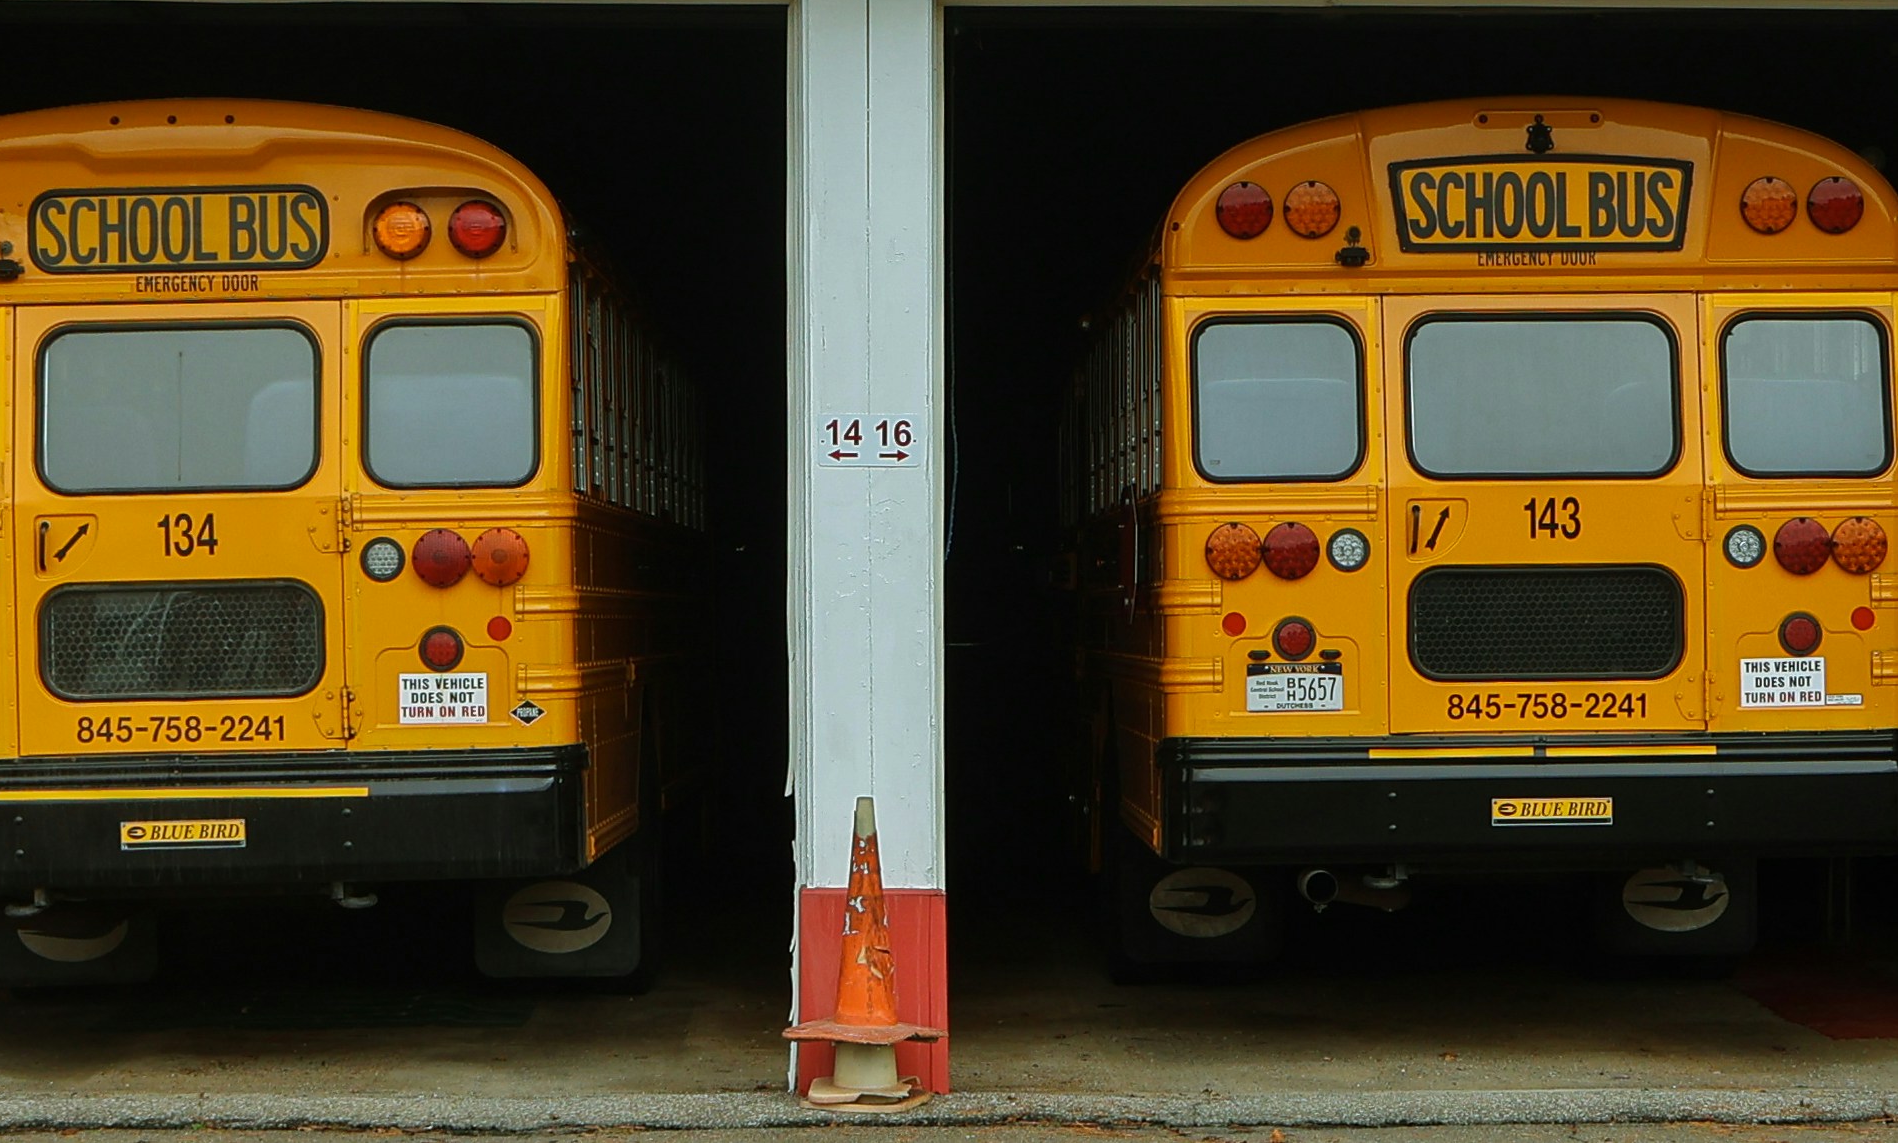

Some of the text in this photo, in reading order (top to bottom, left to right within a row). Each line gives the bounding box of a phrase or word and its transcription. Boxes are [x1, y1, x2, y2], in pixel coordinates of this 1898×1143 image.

[1409, 170, 1675, 239] SCHOOL BUS
[39, 194, 319, 264] SCHOOL BUS
[135, 274, 259, 293] EMERGENCY DOOR
[825, 419, 912, 447] 14 16
[1524, 496, 1581, 540] 143
[157, 513, 219, 557] 134
[1270, 665, 1320, 673] NEW YORK
[1744, 660, 1821, 673] THIS VEHICLE
[401, 677, 485, 690] THIS VEHICLE
[1297, 677, 1337, 701] 5657
[1755, 676, 1812, 688] DOES NOT
[411, 692, 475, 704] DOES NOT
[1447, 692, 1647, 719] 845-758-2241
[1744, 692, 1775, 703] TURN
[1779, 691, 1795, 703] ON
[1799, 691, 1822, 702] RED
[401, 705, 485, 718] TURN ON RED
[76, 715, 285, 743] 845-758-2241
[1520, 801, 1607, 817] BLUE BIRD
[149, 823, 240, 840] BLUE BIRD
